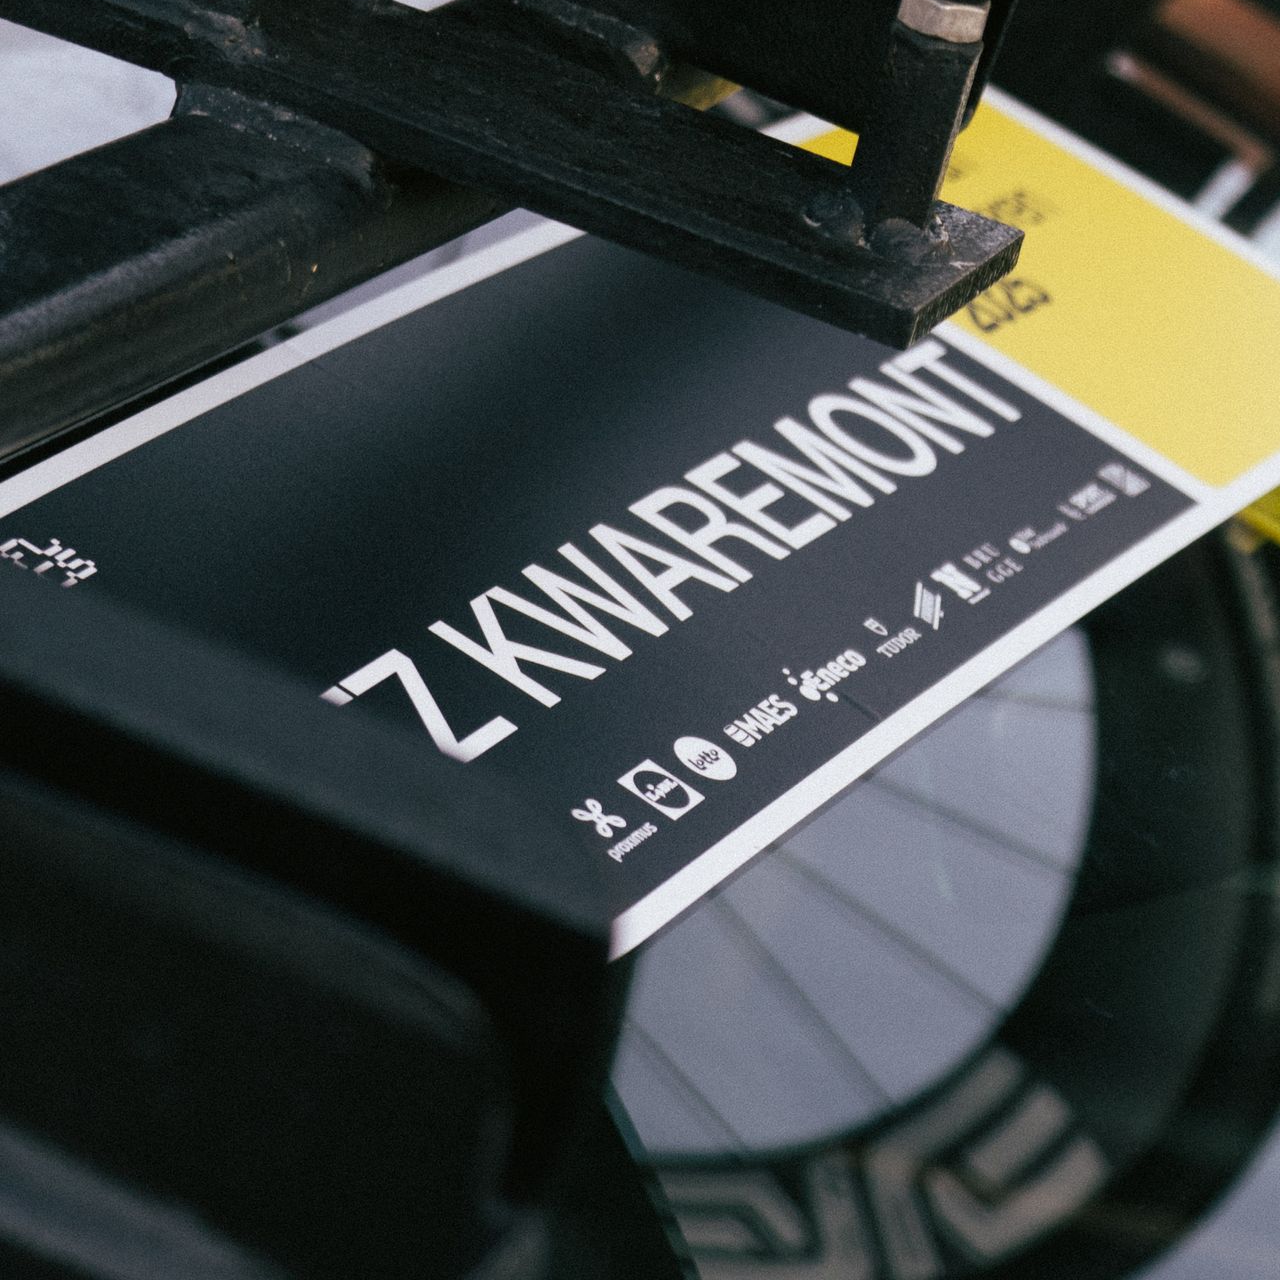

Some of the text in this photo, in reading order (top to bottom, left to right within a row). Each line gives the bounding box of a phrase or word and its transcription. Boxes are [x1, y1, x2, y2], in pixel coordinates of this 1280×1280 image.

[428, 340, 1022, 709] KWAREMONT
[875, 626, 922, 659] TUDOR
[734, 693, 798, 741] MAES
[607, 821, 659, 864] proximus
